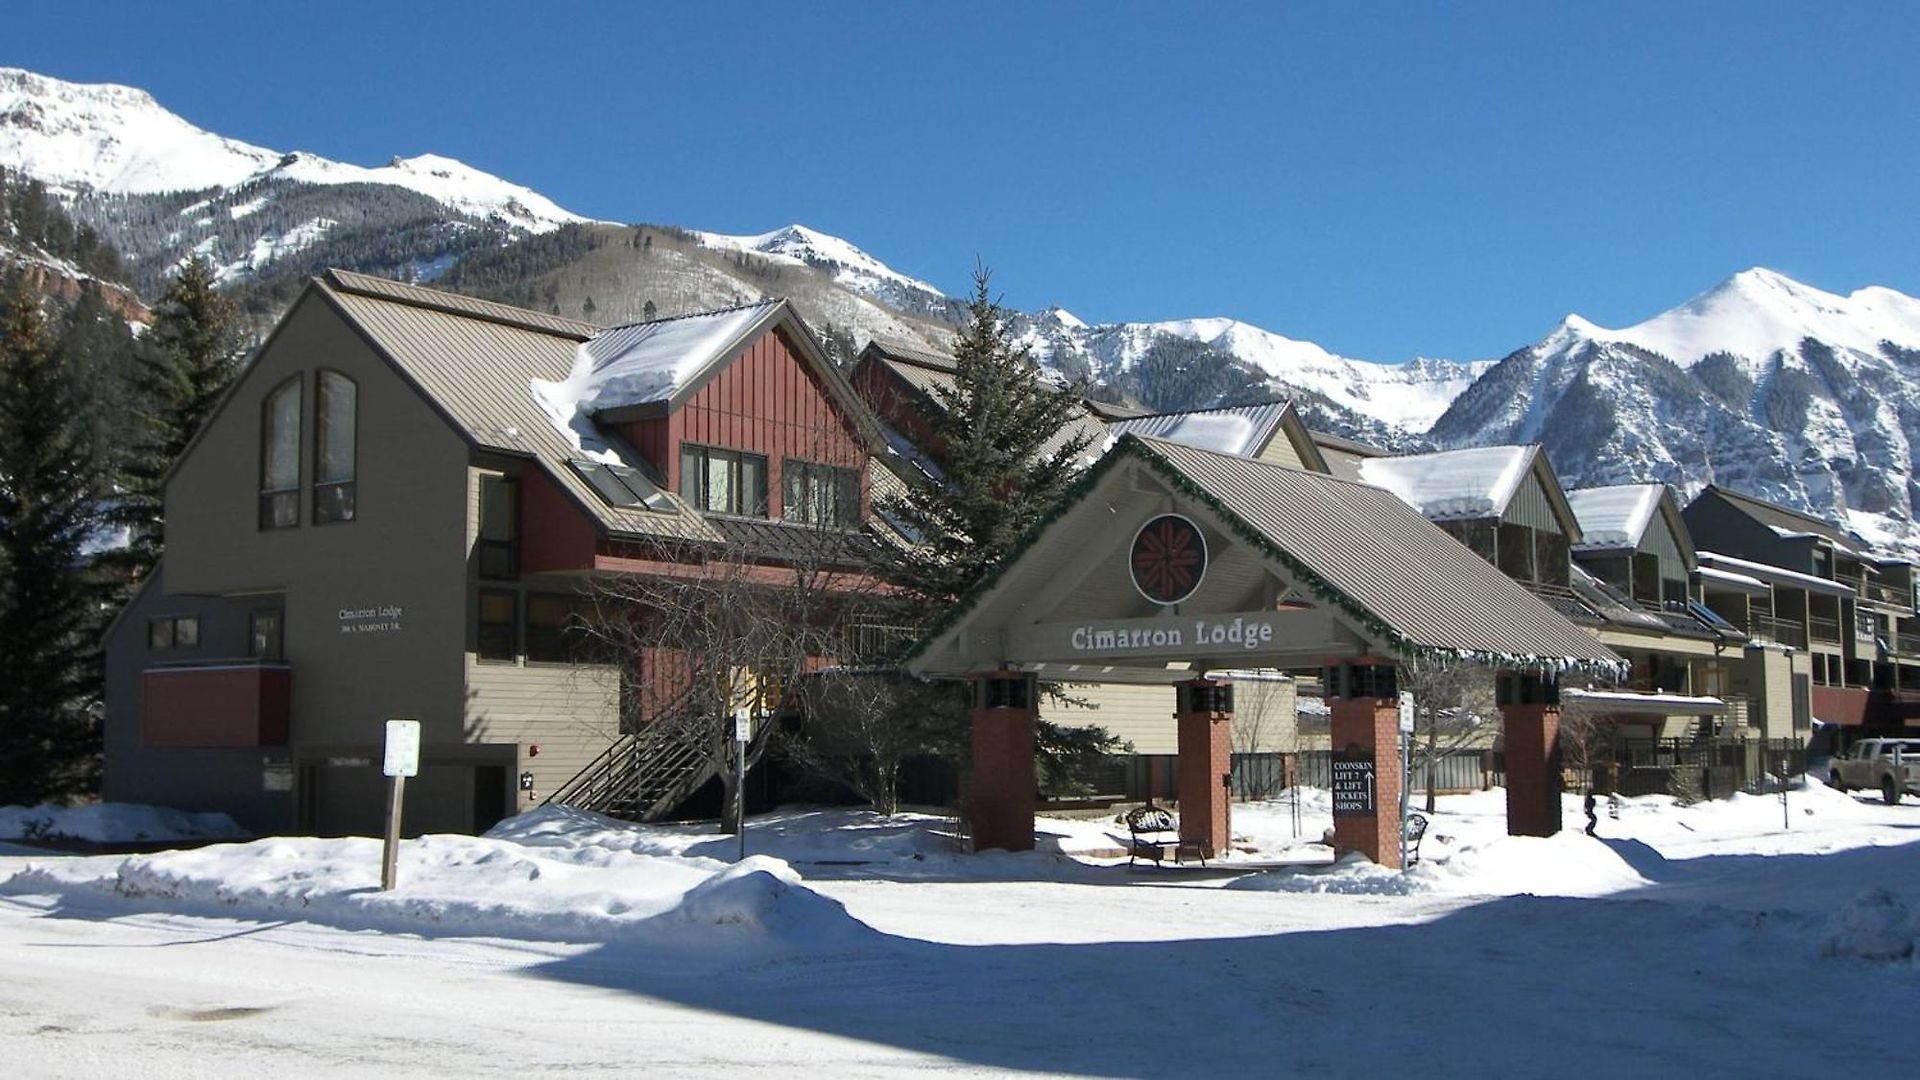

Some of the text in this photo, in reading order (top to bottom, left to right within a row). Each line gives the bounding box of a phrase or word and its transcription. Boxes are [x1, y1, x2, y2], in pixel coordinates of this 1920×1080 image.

[378, 605, 402, 619] Lodge
[1071, 618, 1273, 650] Cimarron Lodge
[1333, 761, 1373, 770] COONSKIN
[1335, 771, 1352, 780] LIFT
[1343, 781, 1361, 790] LIFT
[1336, 791, 1368, 800] TICKETS
[1335, 801, 1362, 810] SHOPS
